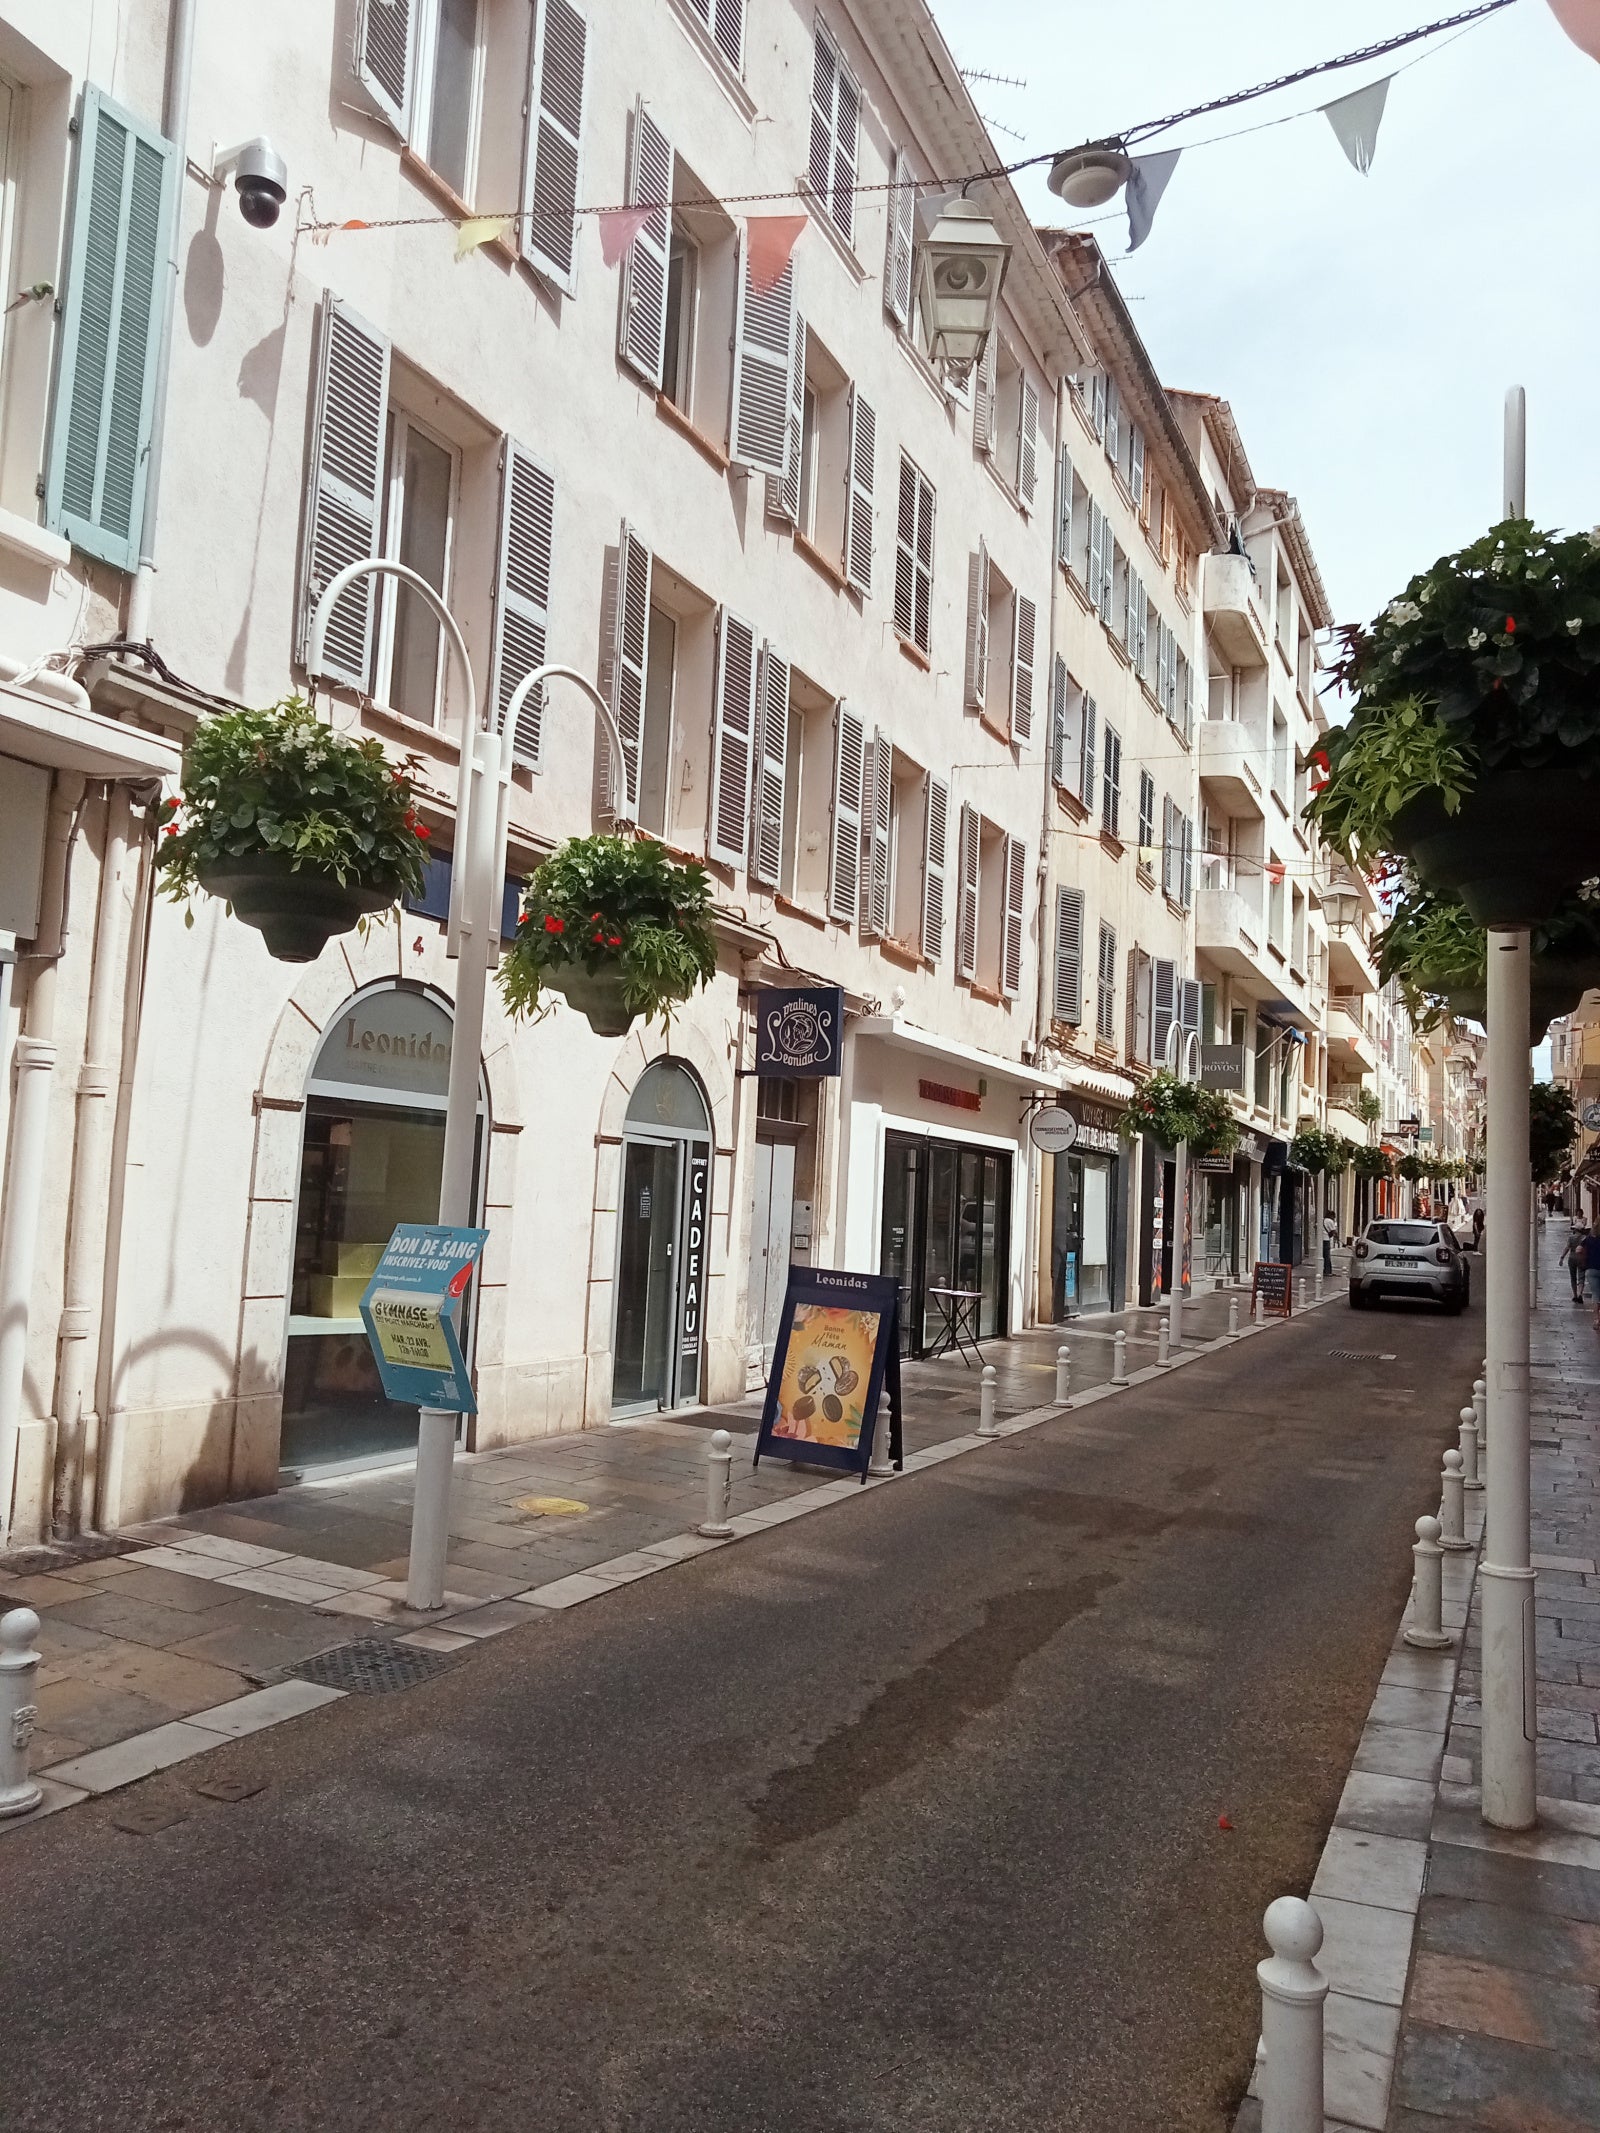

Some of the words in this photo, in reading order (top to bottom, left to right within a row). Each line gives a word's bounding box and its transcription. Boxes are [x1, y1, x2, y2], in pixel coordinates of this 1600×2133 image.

[412, 935, 424, 956] 4
[782, 997, 818, 1018] pralines
[345, 1018, 452, 1062] Leonida
[1202, 1064, 1240, 1073] ROVOST
[1082, 1103, 1103, 1127] VOYAGE
[1105, 1111, 1113, 1130] AU
[389, 1237, 419, 1255] DON
[420, 1239, 440, 1256] DE
[438, 1240, 478, 1259] SANG
[685, 1171, 704, 1333] CADEAU
[383, 1255, 450, 1271] INSCRIVEZ-VOUS
[816, 1273, 868, 1289] Leonidas
[375, 1302, 428, 1322] GYMNASE
[824, 1325, 845, 1334] Bonne
[811, 1332, 847, 1351] Maman
